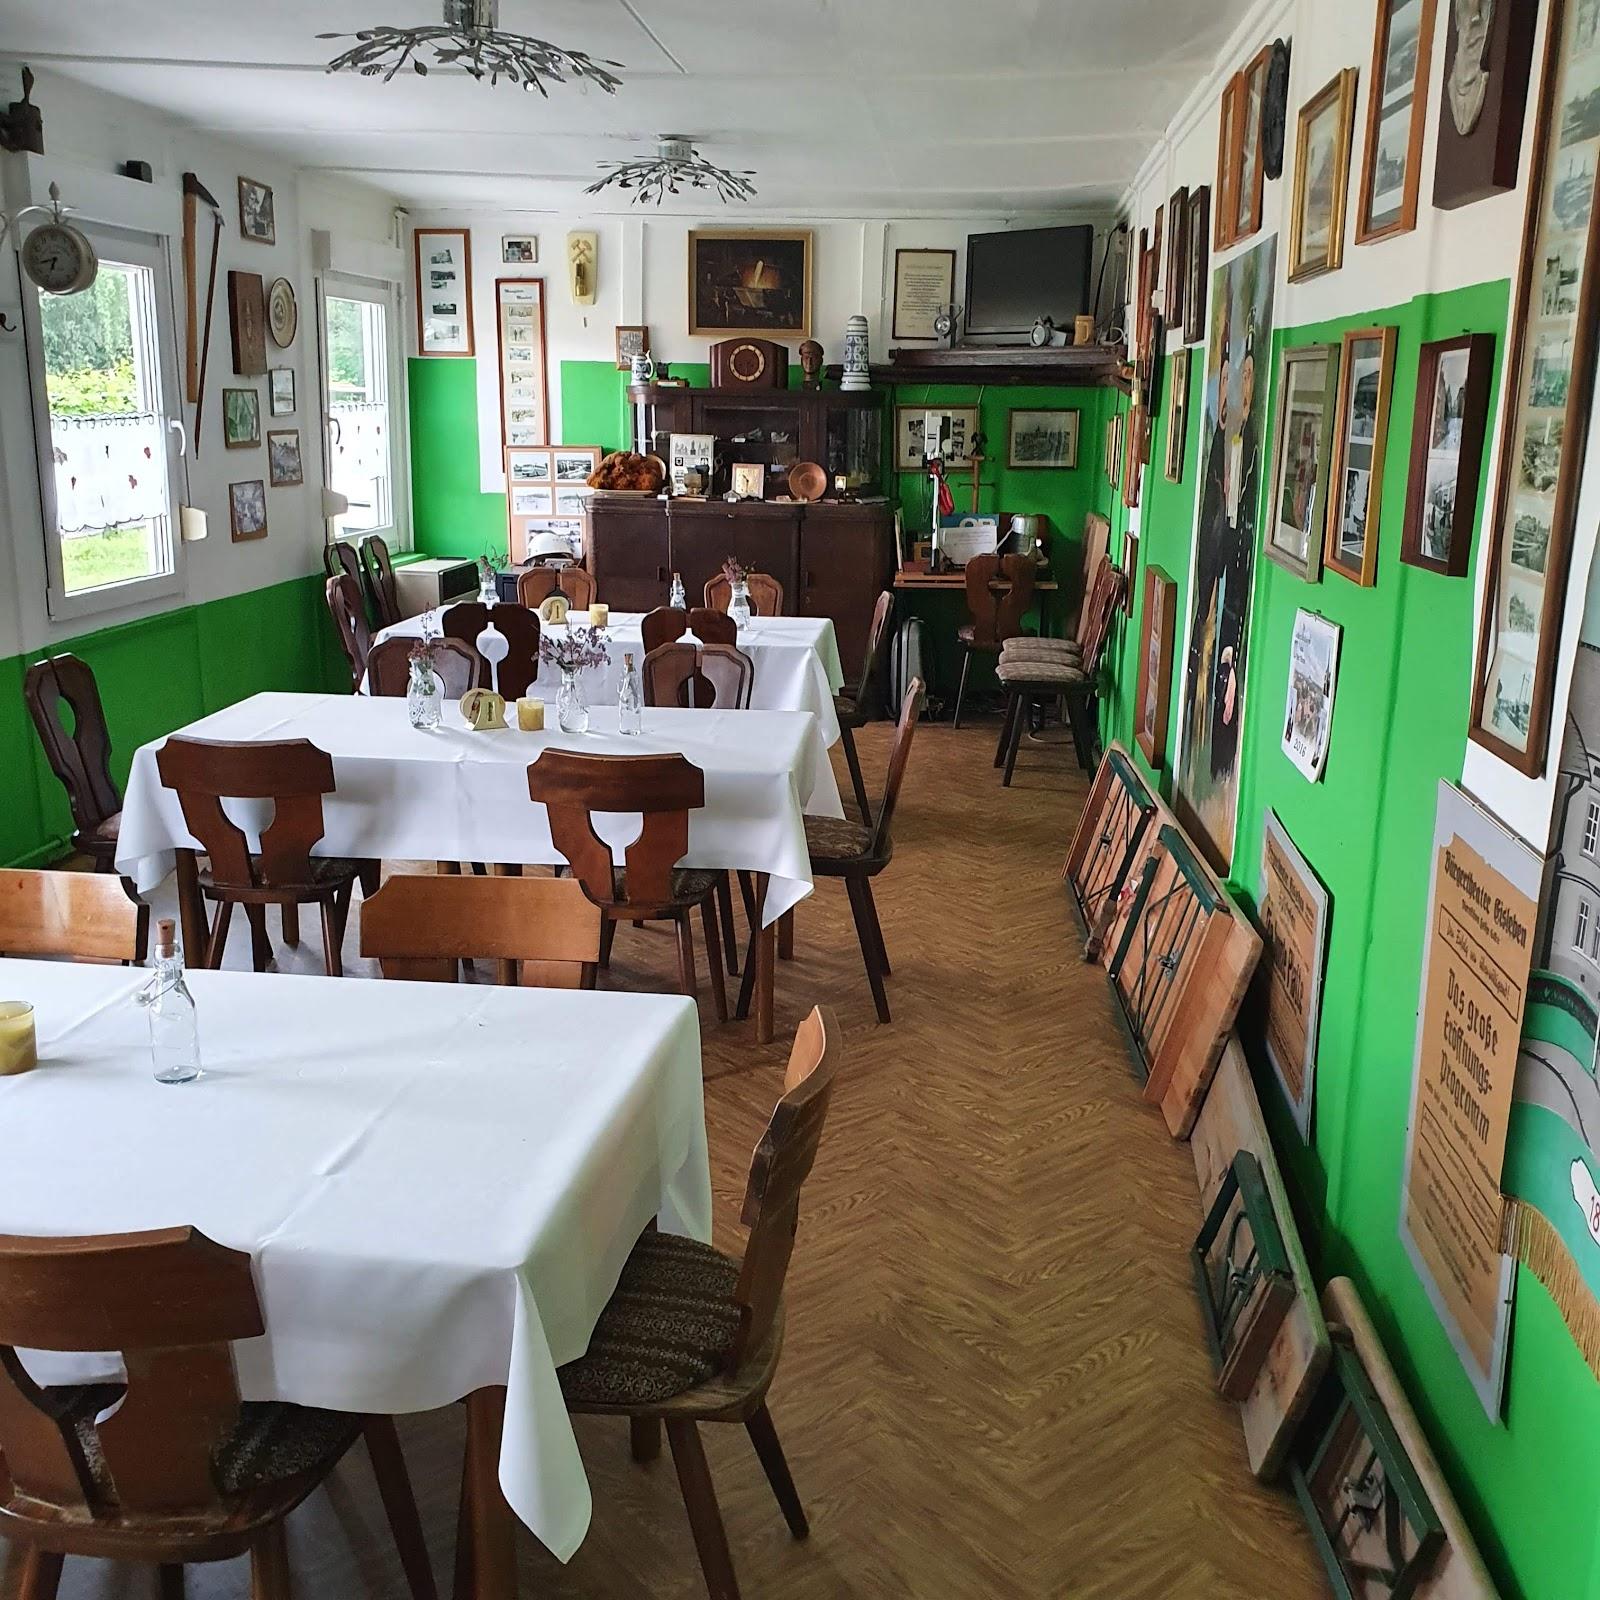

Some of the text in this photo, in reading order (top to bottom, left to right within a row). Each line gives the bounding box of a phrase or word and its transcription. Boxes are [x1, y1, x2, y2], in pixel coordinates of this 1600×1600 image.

[1293, 738, 1307, 758] 2016
[1443, 1010, 1493, 1095] Eröffnungs-
[1447, 967, 1499, 1056] Das große
[1440, 1049, 1490, 1145] Programm
